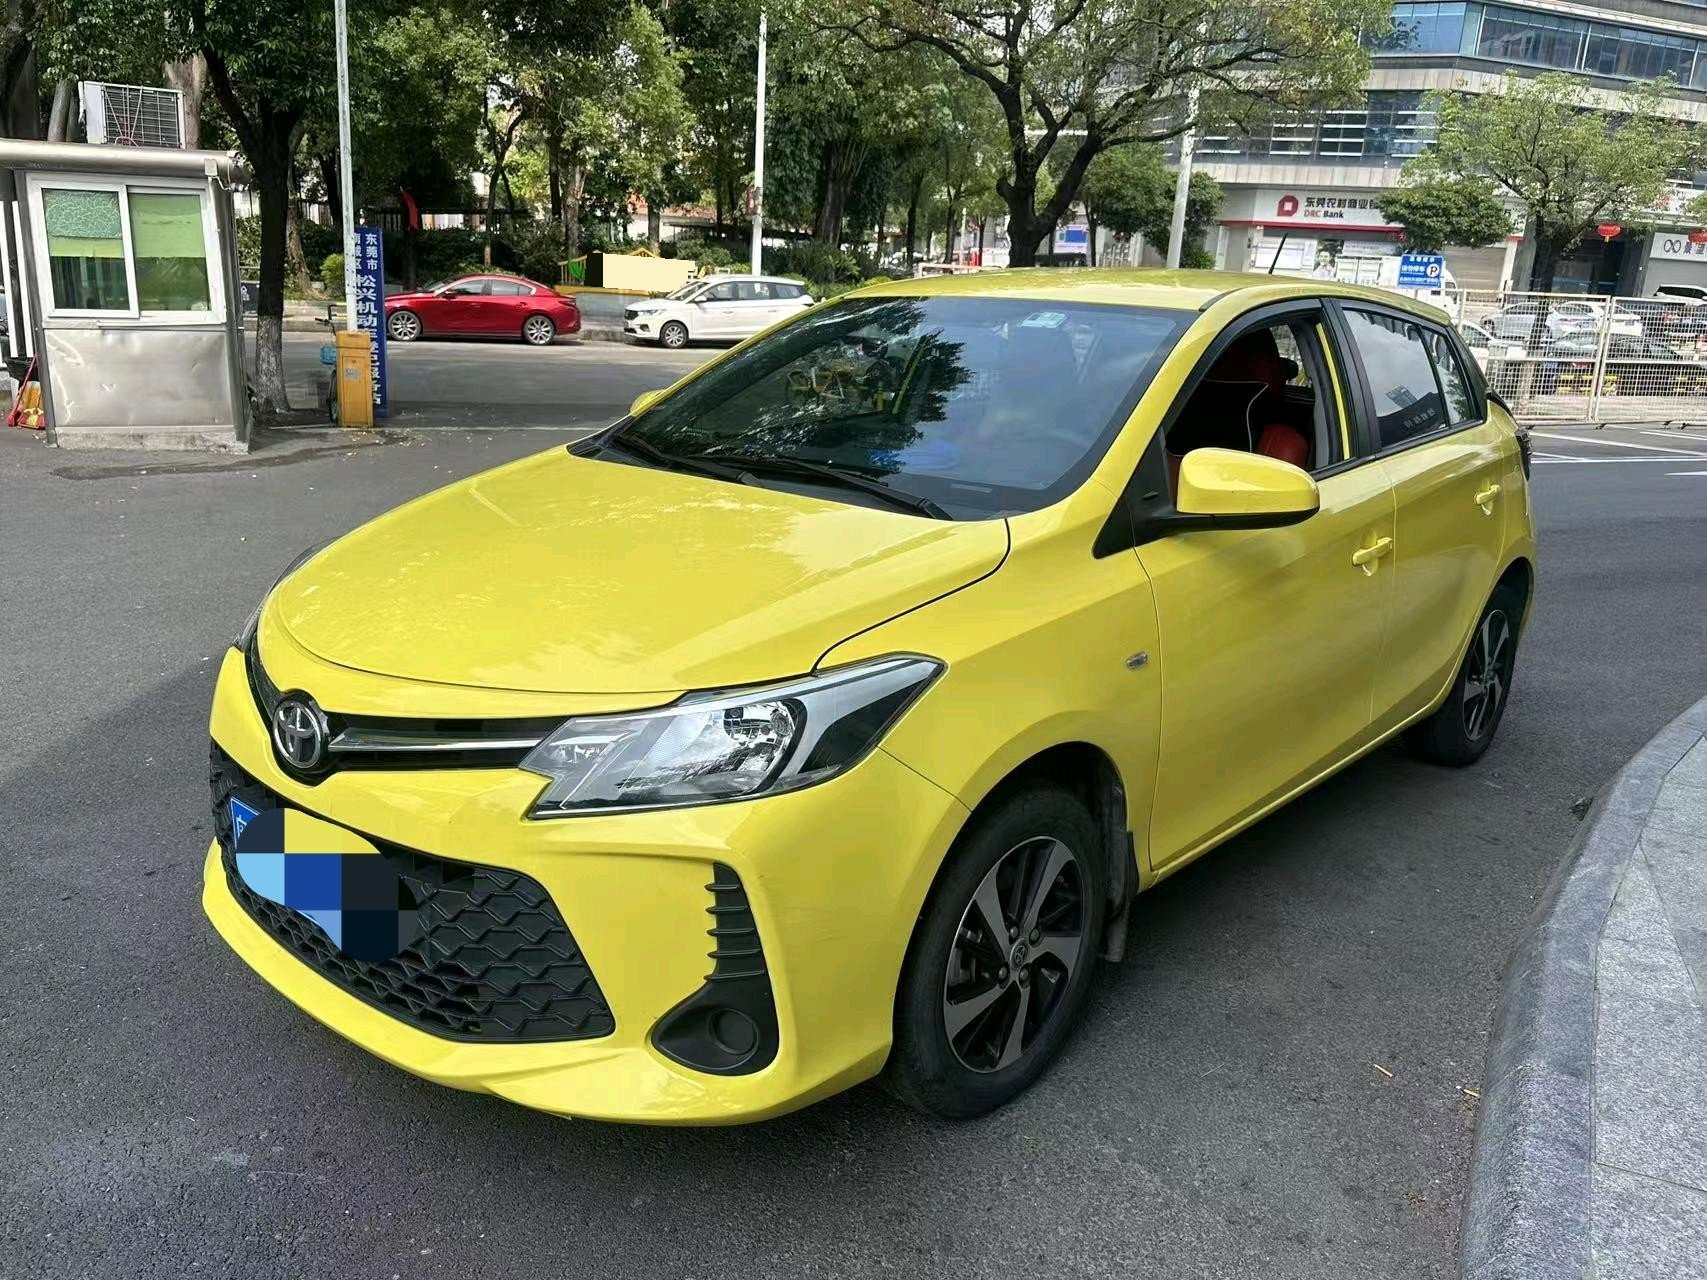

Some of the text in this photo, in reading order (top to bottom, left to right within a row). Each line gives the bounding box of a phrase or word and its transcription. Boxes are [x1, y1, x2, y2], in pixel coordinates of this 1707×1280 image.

[1304, 210, 1344, 218] DRC Bank
[365, 232, 378, 270] 东莞市
